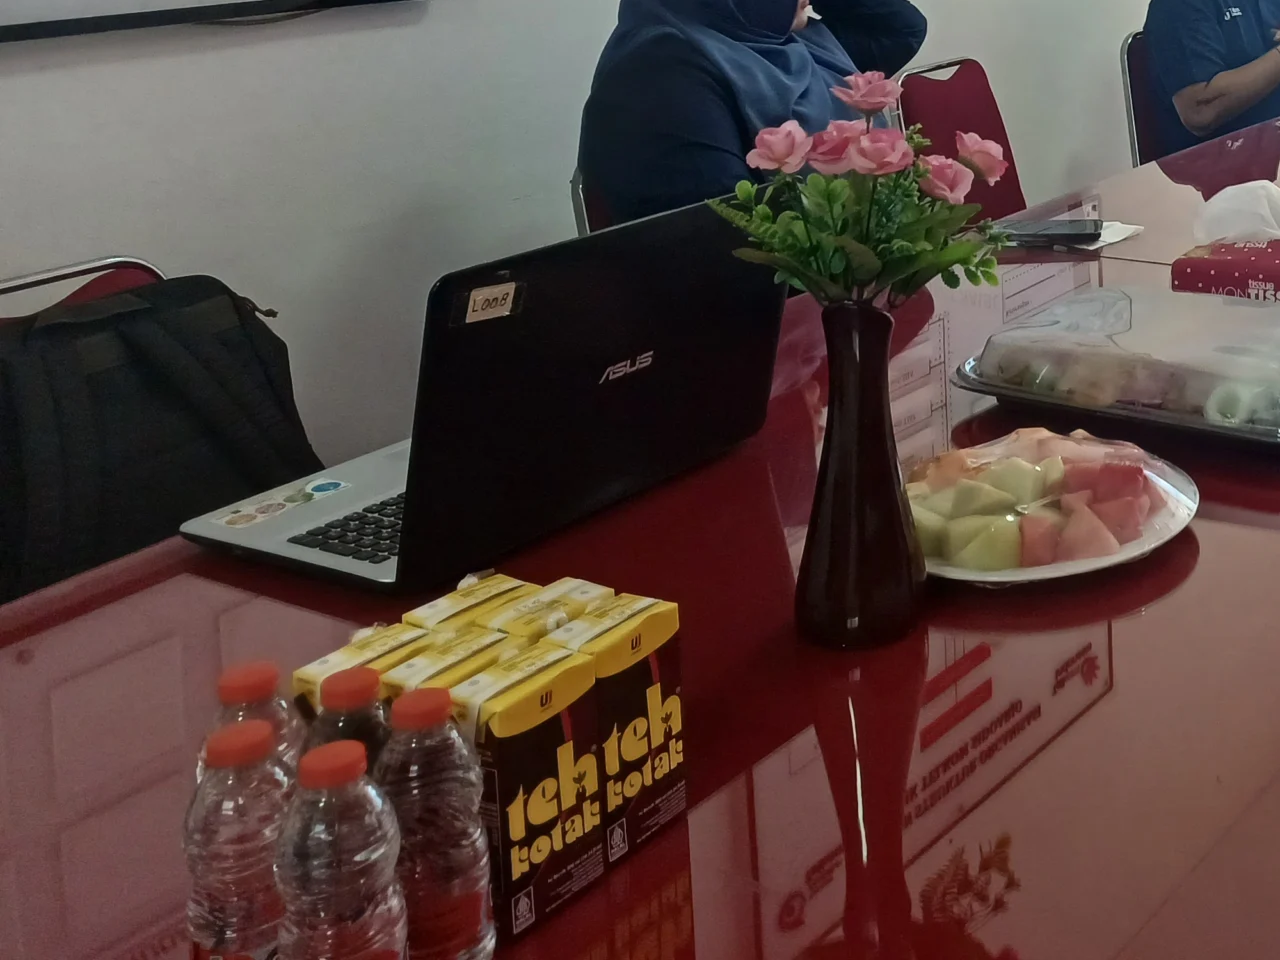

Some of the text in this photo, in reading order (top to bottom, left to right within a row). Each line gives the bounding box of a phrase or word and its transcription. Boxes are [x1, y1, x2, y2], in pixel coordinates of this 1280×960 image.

[1248, 279, 1274, 290] tissue
[599, 350, 654, 385] ASUS
[602, 682, 682, 776] teh
[506, 740, 599, 841] teh
[607, 738, 683, 813] kotak
[511, 798, 600, 881] kotak
